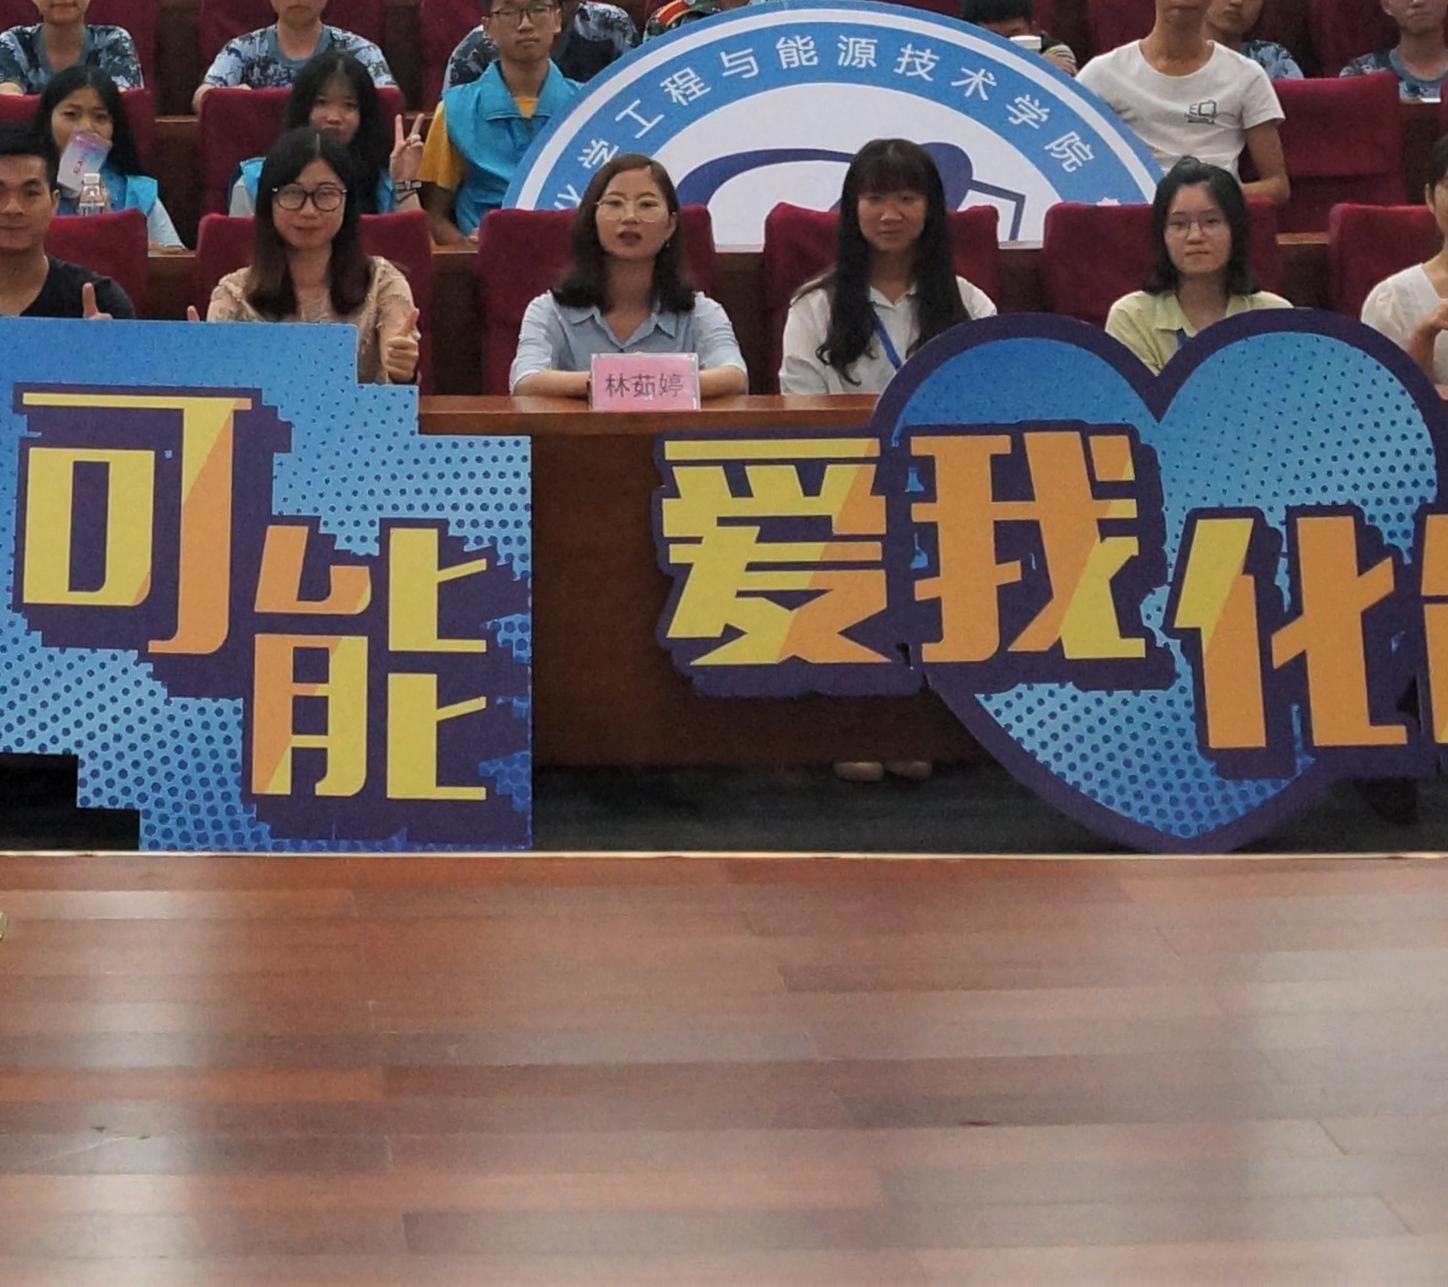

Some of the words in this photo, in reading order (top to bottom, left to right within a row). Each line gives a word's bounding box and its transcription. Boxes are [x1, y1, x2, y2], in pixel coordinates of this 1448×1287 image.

[605, 372, 684, 398] 林茹婷
[21, 391, 489, 801] 可能
